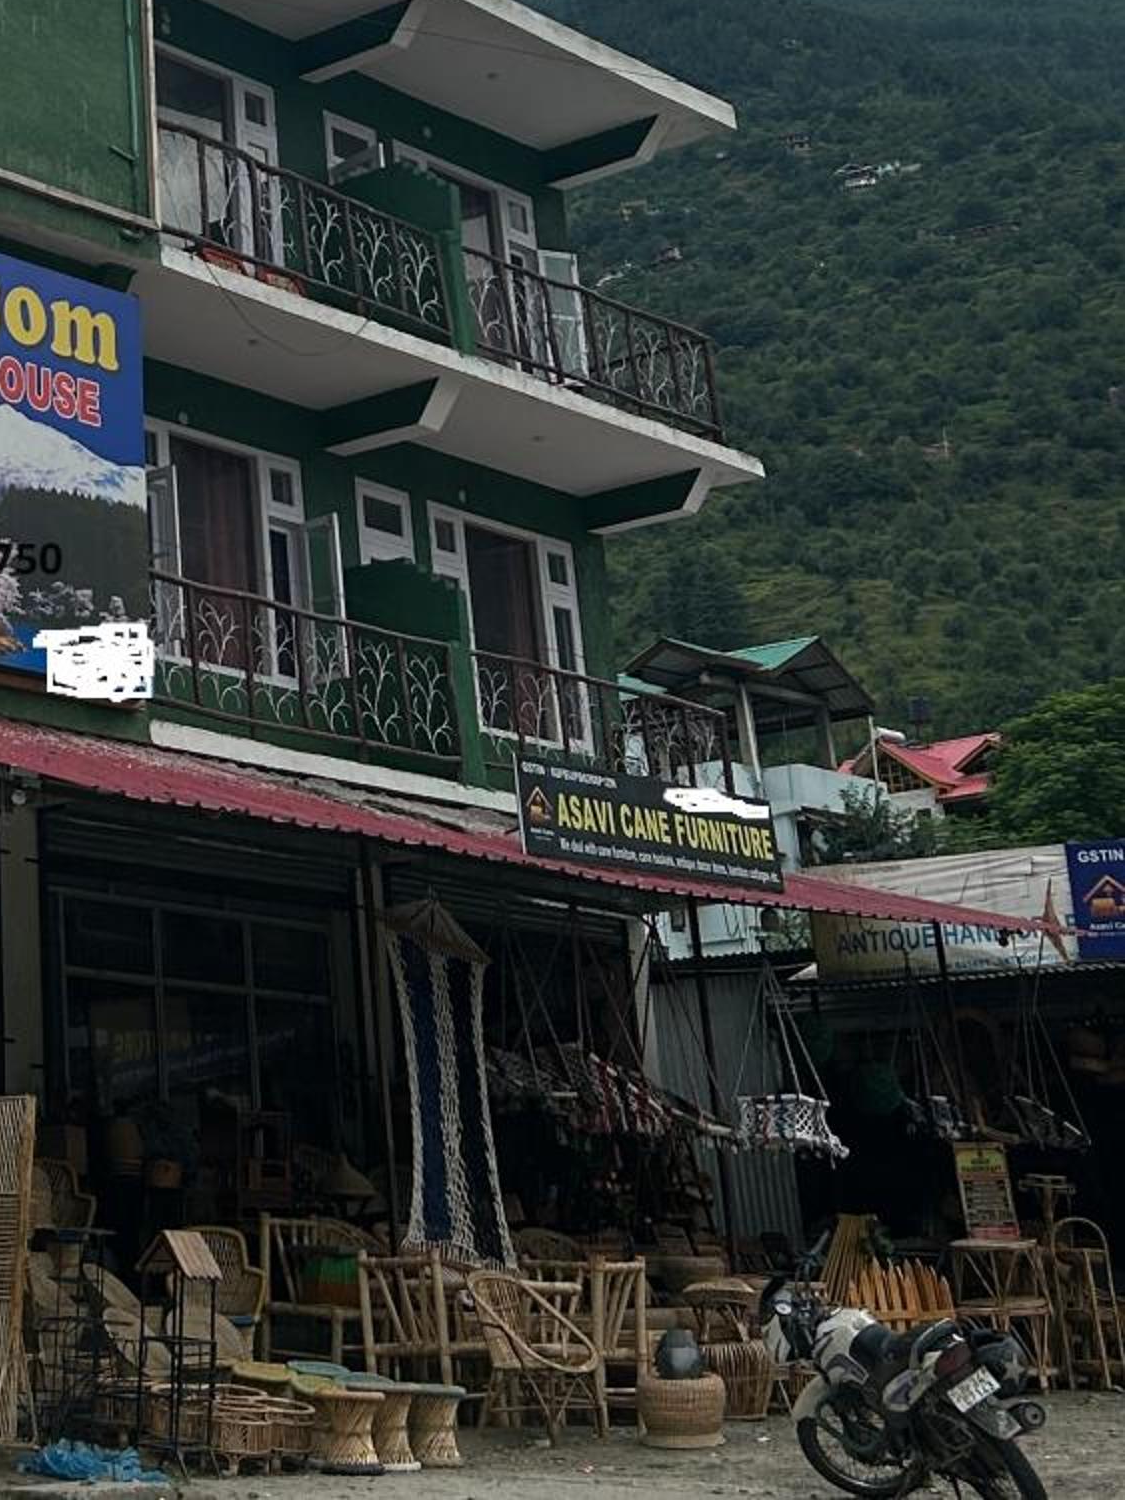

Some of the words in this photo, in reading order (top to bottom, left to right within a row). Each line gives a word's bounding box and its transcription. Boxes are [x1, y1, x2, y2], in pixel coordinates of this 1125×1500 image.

[557, 793, 616, 835] ASAVI
[621, 803, 672, 844] CANE
[674, 814, 773, 861] FURNITURE
[1078, 848, 1124, 863] GSTIN
[836, 923, 934, 955] ANTIQUE
